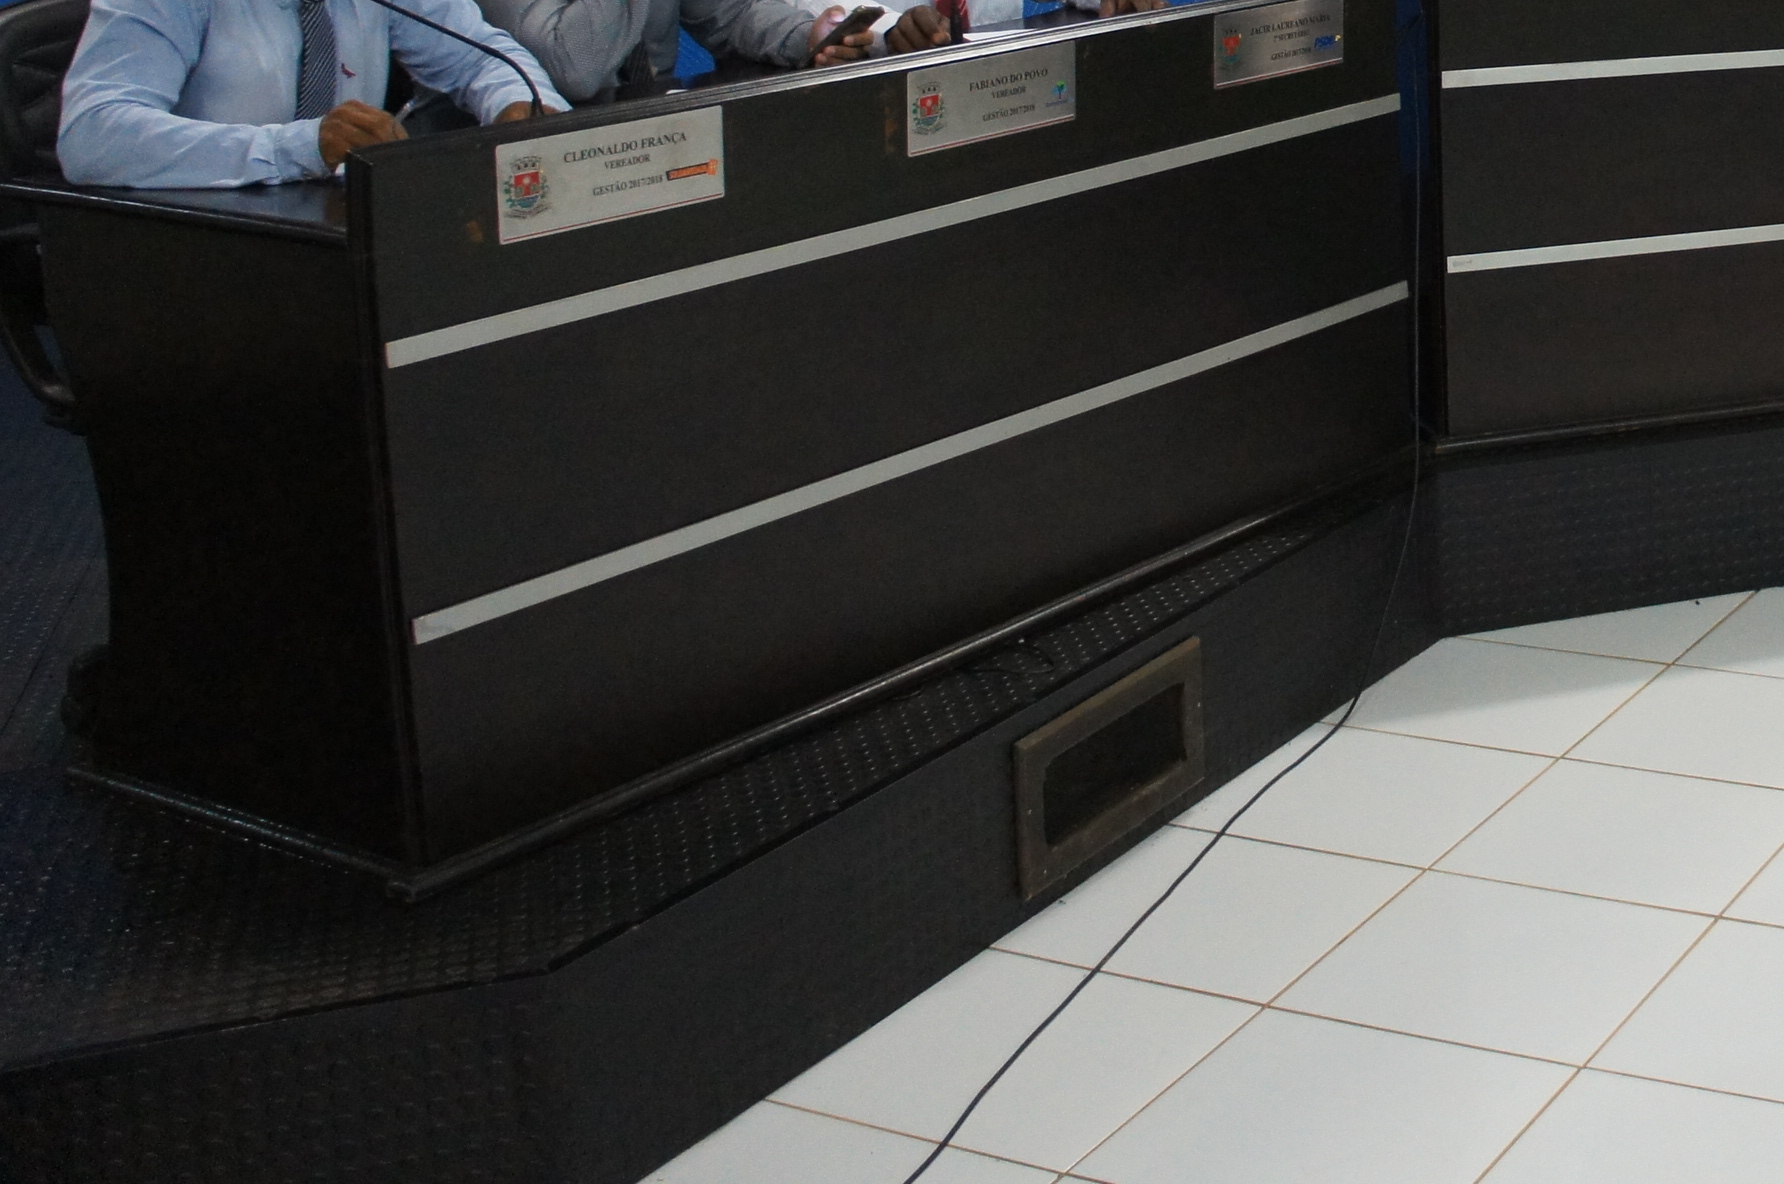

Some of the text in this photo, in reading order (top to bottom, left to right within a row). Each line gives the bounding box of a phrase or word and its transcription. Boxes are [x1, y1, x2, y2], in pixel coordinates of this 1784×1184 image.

[1250, 24, 1271, 35] JACIR
[969, 68, 1048, 92] FABIANO DO POVO
[991, 86, 1027, 99] VEREADOR
[983, 108, 1009, 122] GESTÃO
[564, 132, 687, 163] CLEONALDO FRANÇA
[604, 154, 651, 170] VEREADOR
[593, 175, 663, 197] GESTÃO 2017/2018
